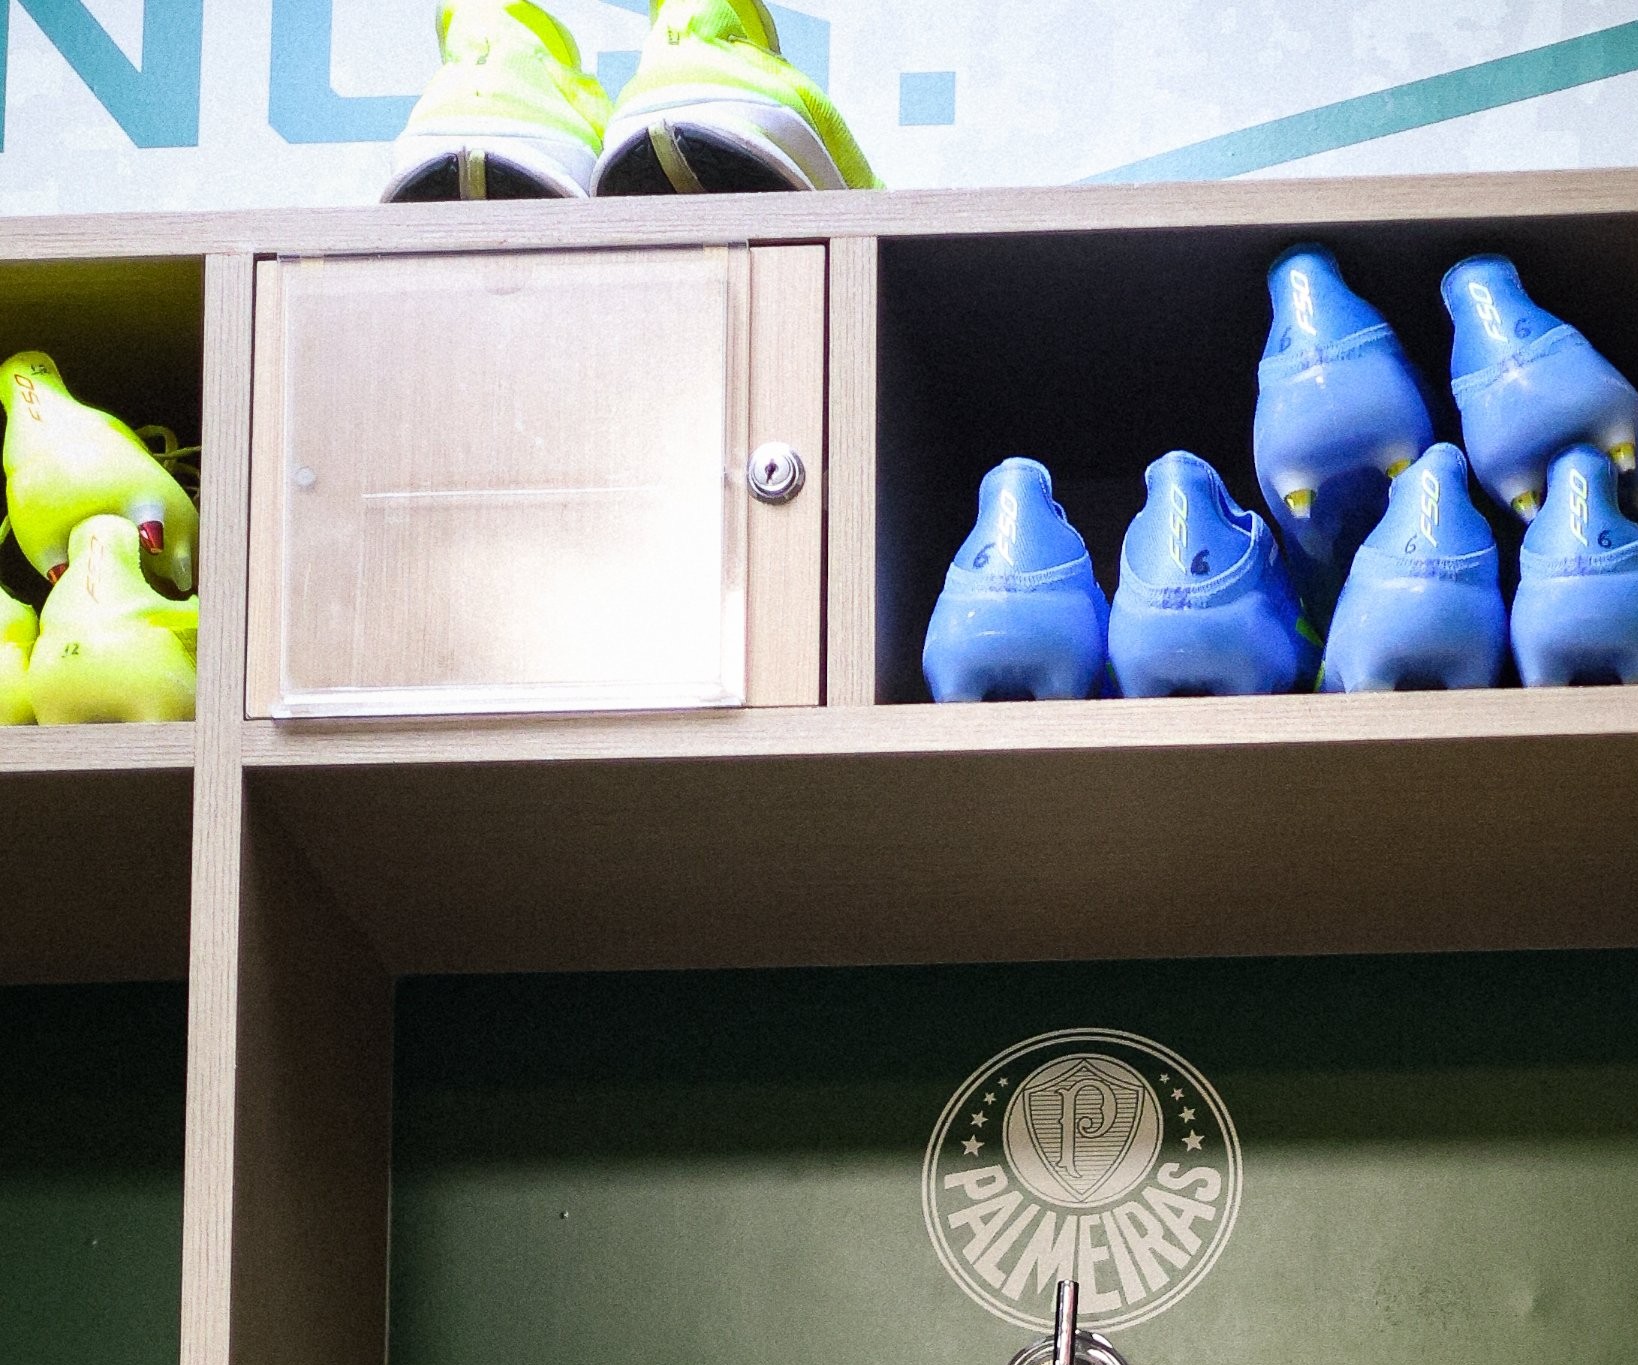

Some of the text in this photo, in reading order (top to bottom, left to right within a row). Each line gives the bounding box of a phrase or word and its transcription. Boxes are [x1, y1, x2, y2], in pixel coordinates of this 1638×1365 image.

[1405, 533, 1417, 554] 6
[1597, 529, 1612, 549] 6
[972, 542, 995, 570] 6
[1190, 548, 1210, 577] 6
[943, 1160, 1223, 1316] PALMEIRAS
